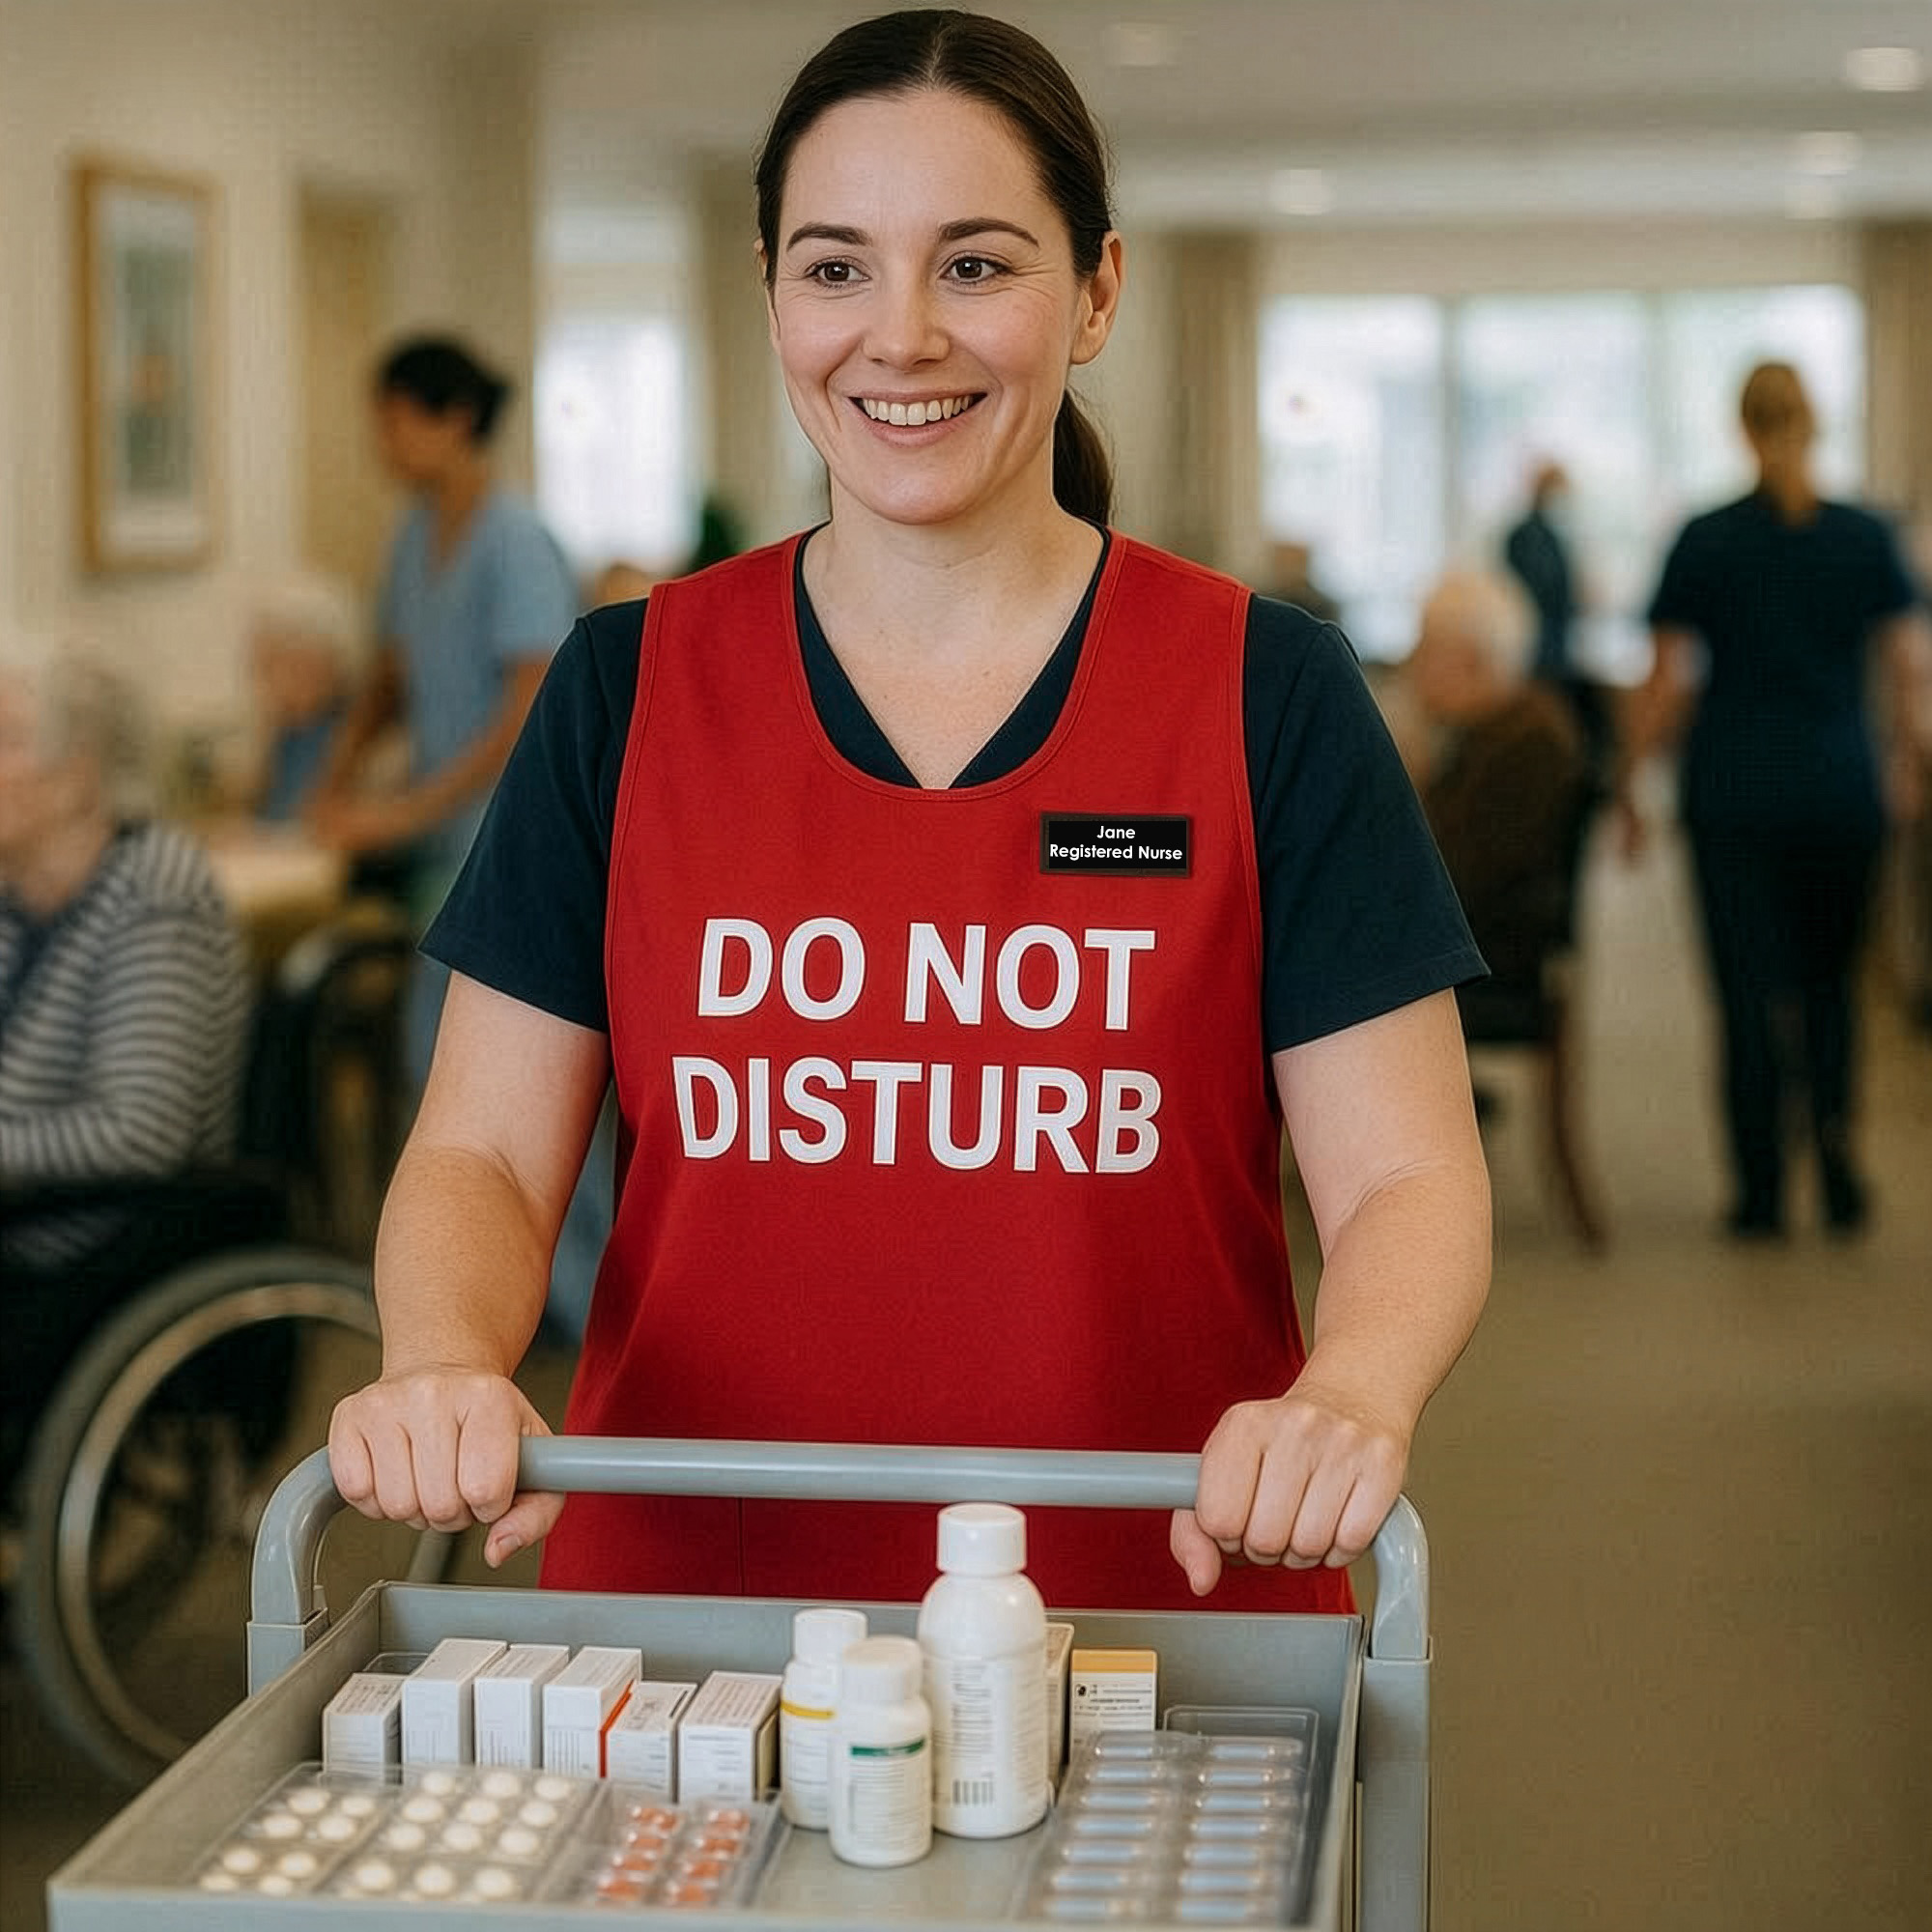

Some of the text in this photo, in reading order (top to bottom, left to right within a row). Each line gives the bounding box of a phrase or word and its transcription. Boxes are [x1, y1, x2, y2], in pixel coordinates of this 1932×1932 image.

[1049, 844, 1183, 861] Registered Nurse
[1096, 826, 1136, 838] Jane
[698, 917, 1155, 1031] DO NOT
[672, 1056, 1162, 1174] DISTURB
